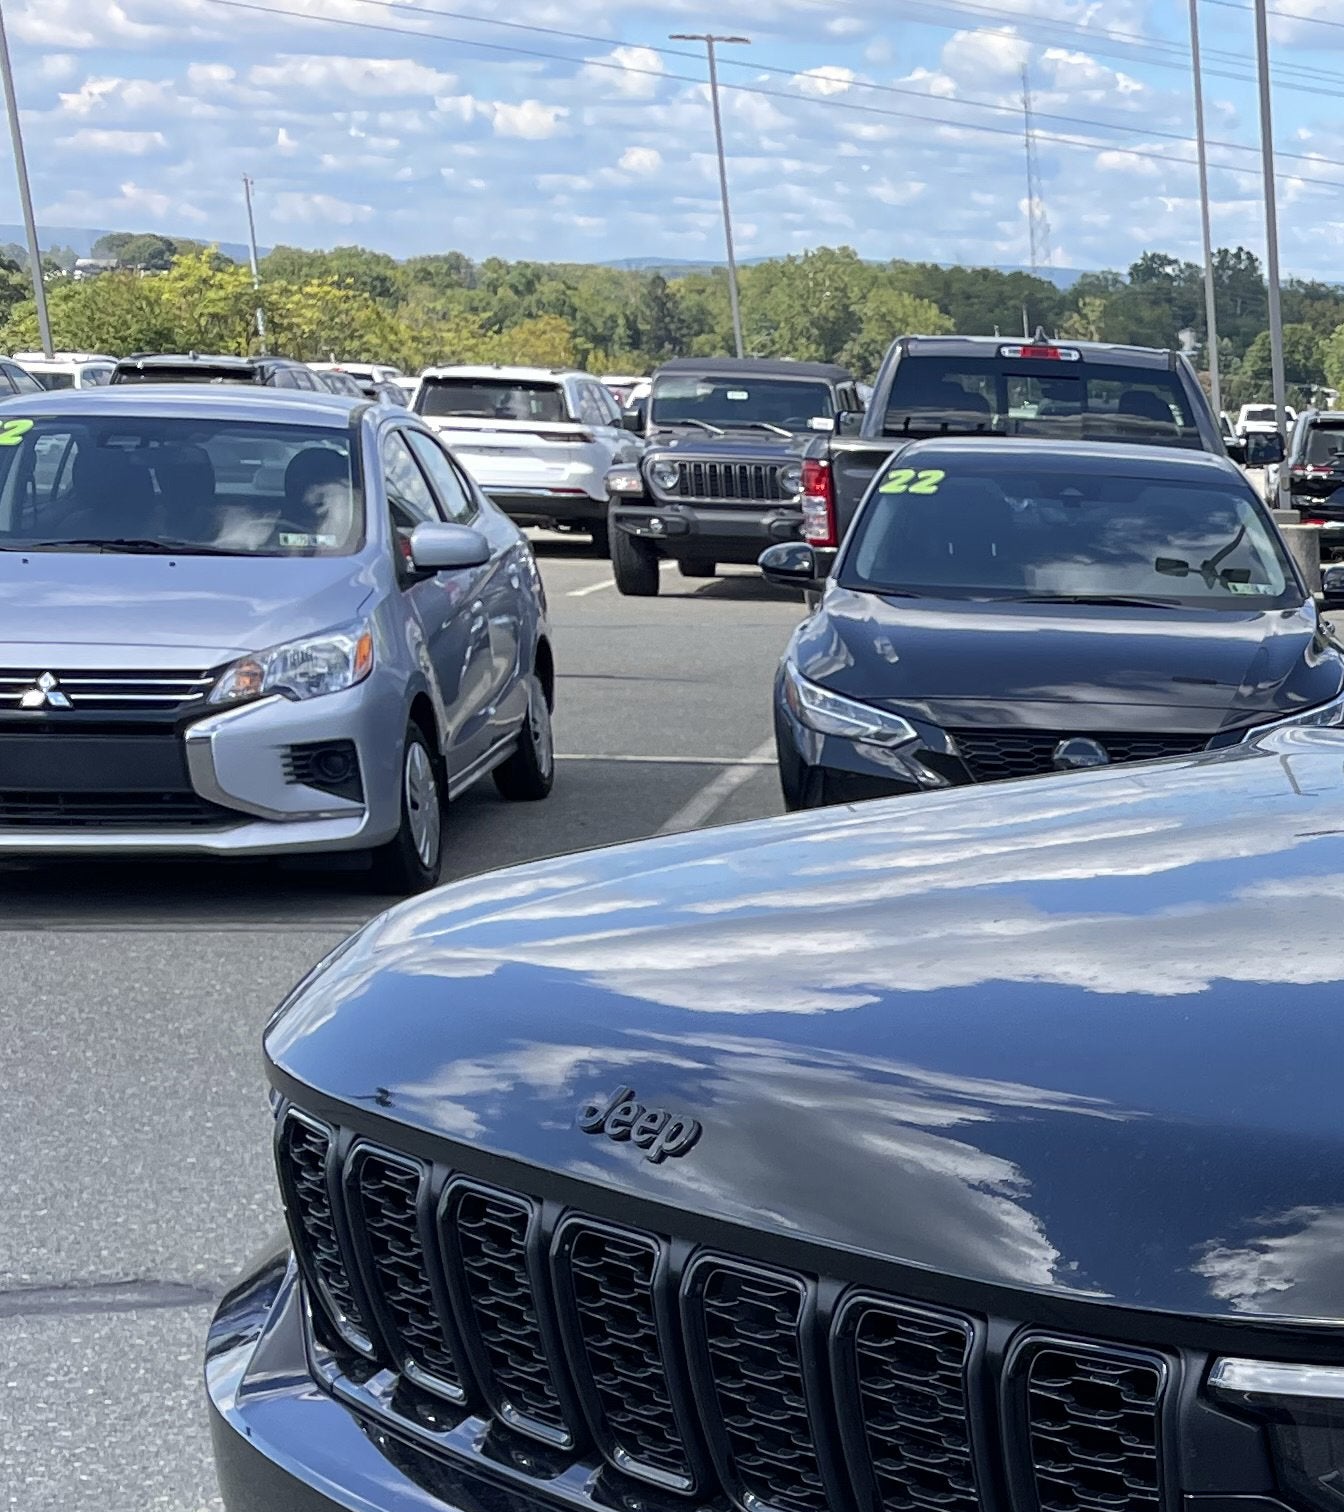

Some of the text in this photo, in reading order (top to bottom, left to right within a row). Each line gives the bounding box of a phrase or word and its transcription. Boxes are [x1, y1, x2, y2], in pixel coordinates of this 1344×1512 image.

[0, 419, 34, 446] 2
[879, 469, 945, 494] 22
[577, 1084, 703, 1164] Jeep
